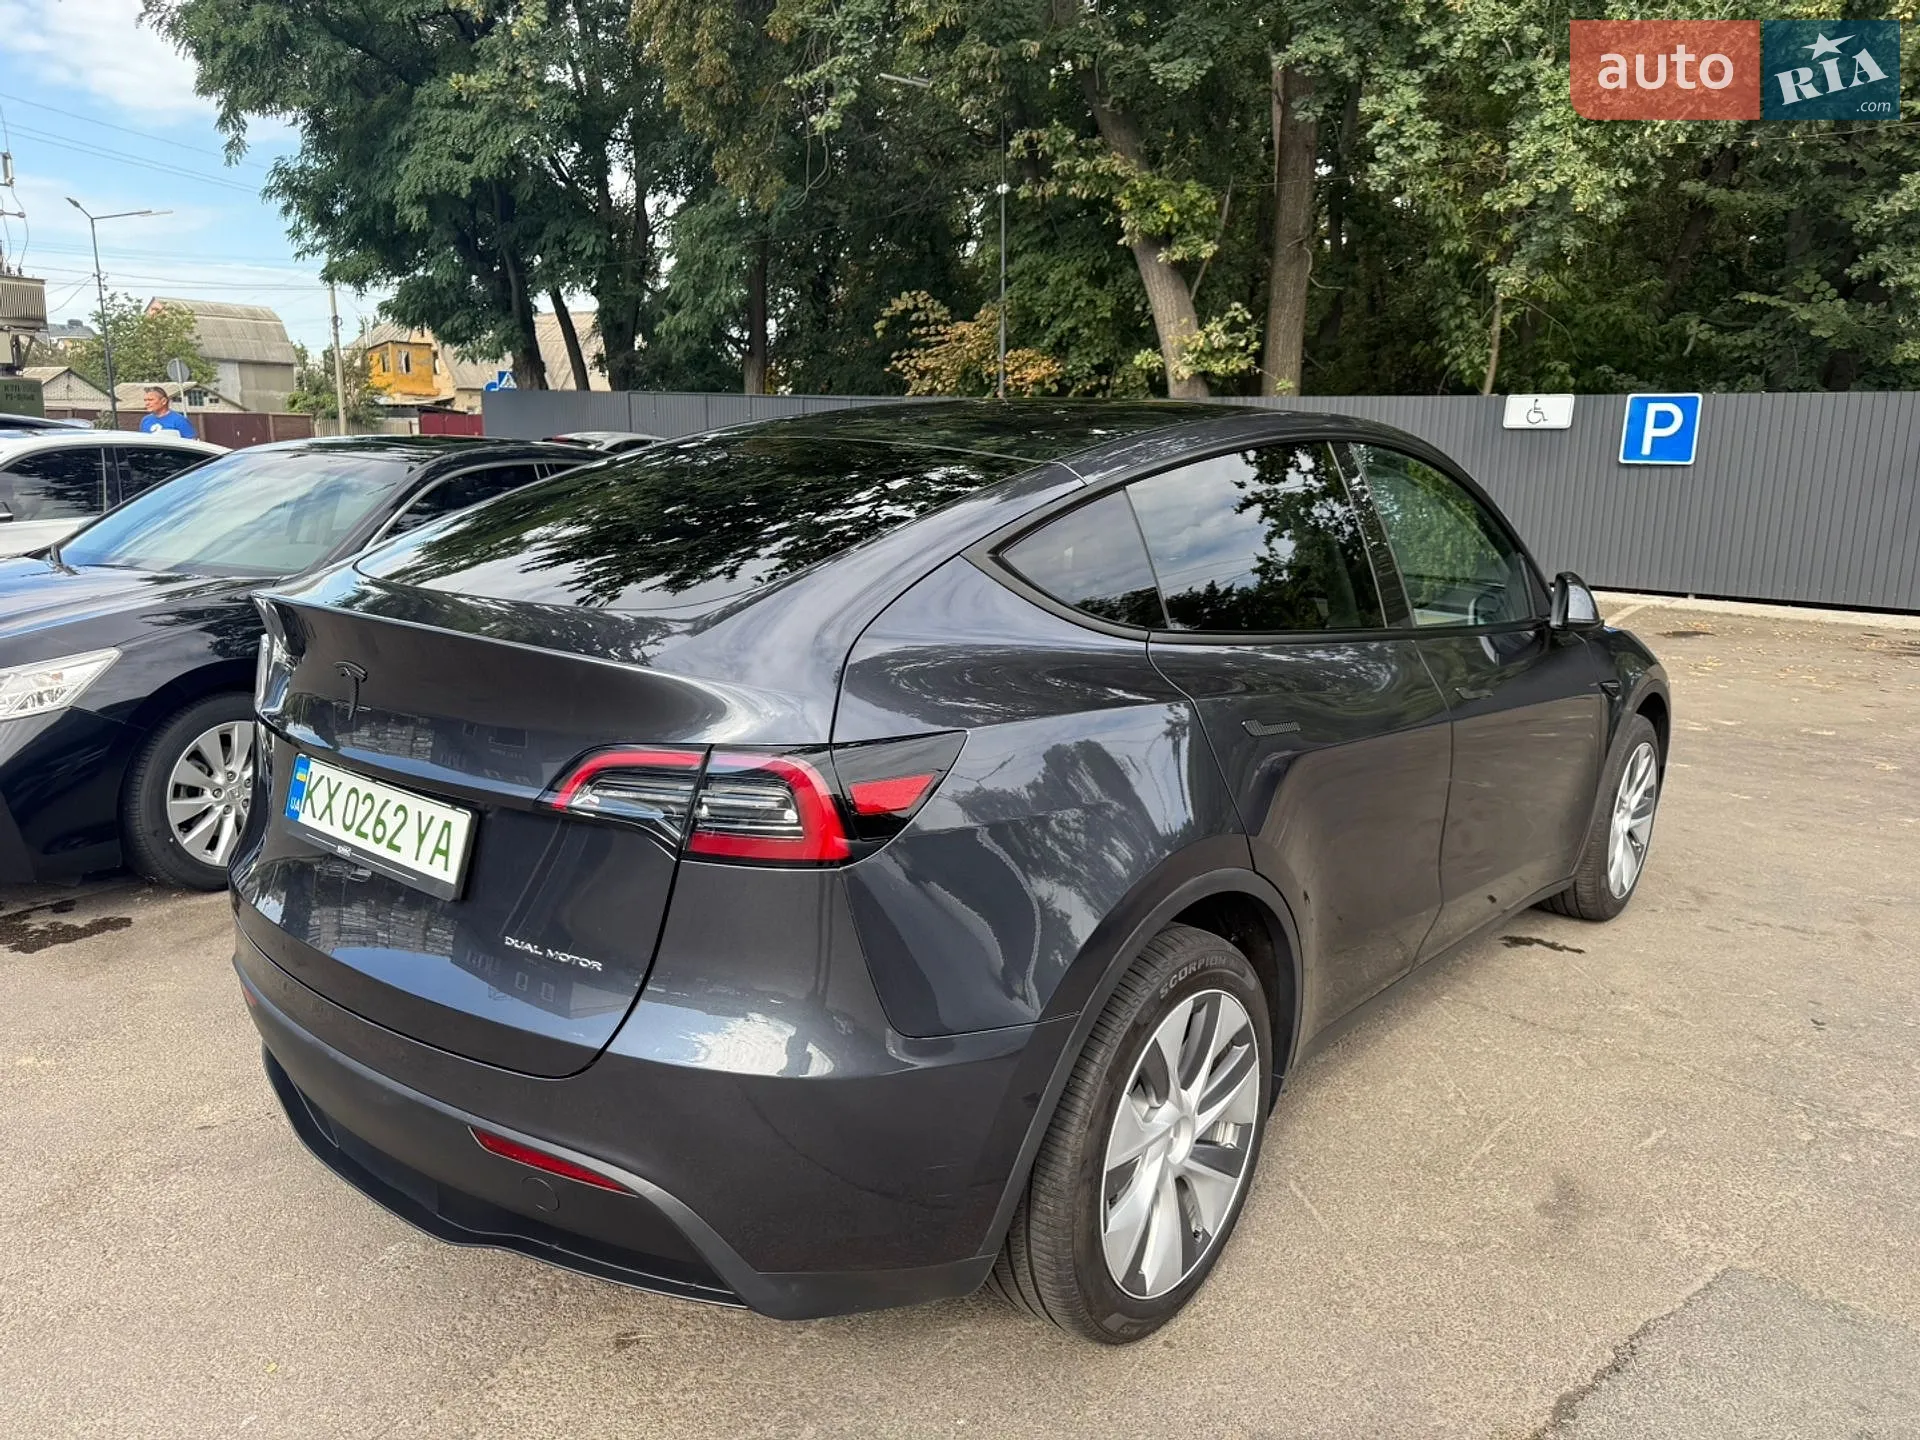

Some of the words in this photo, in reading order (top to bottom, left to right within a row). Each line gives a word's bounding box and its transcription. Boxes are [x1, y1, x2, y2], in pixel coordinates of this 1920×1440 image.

[1641, 402, 1684, 456] P
[504, 936, 543, 956] DUAL
[546, 949, 603, 972] MOTOR
[1160, 955, 1226, 999] SCORPION
